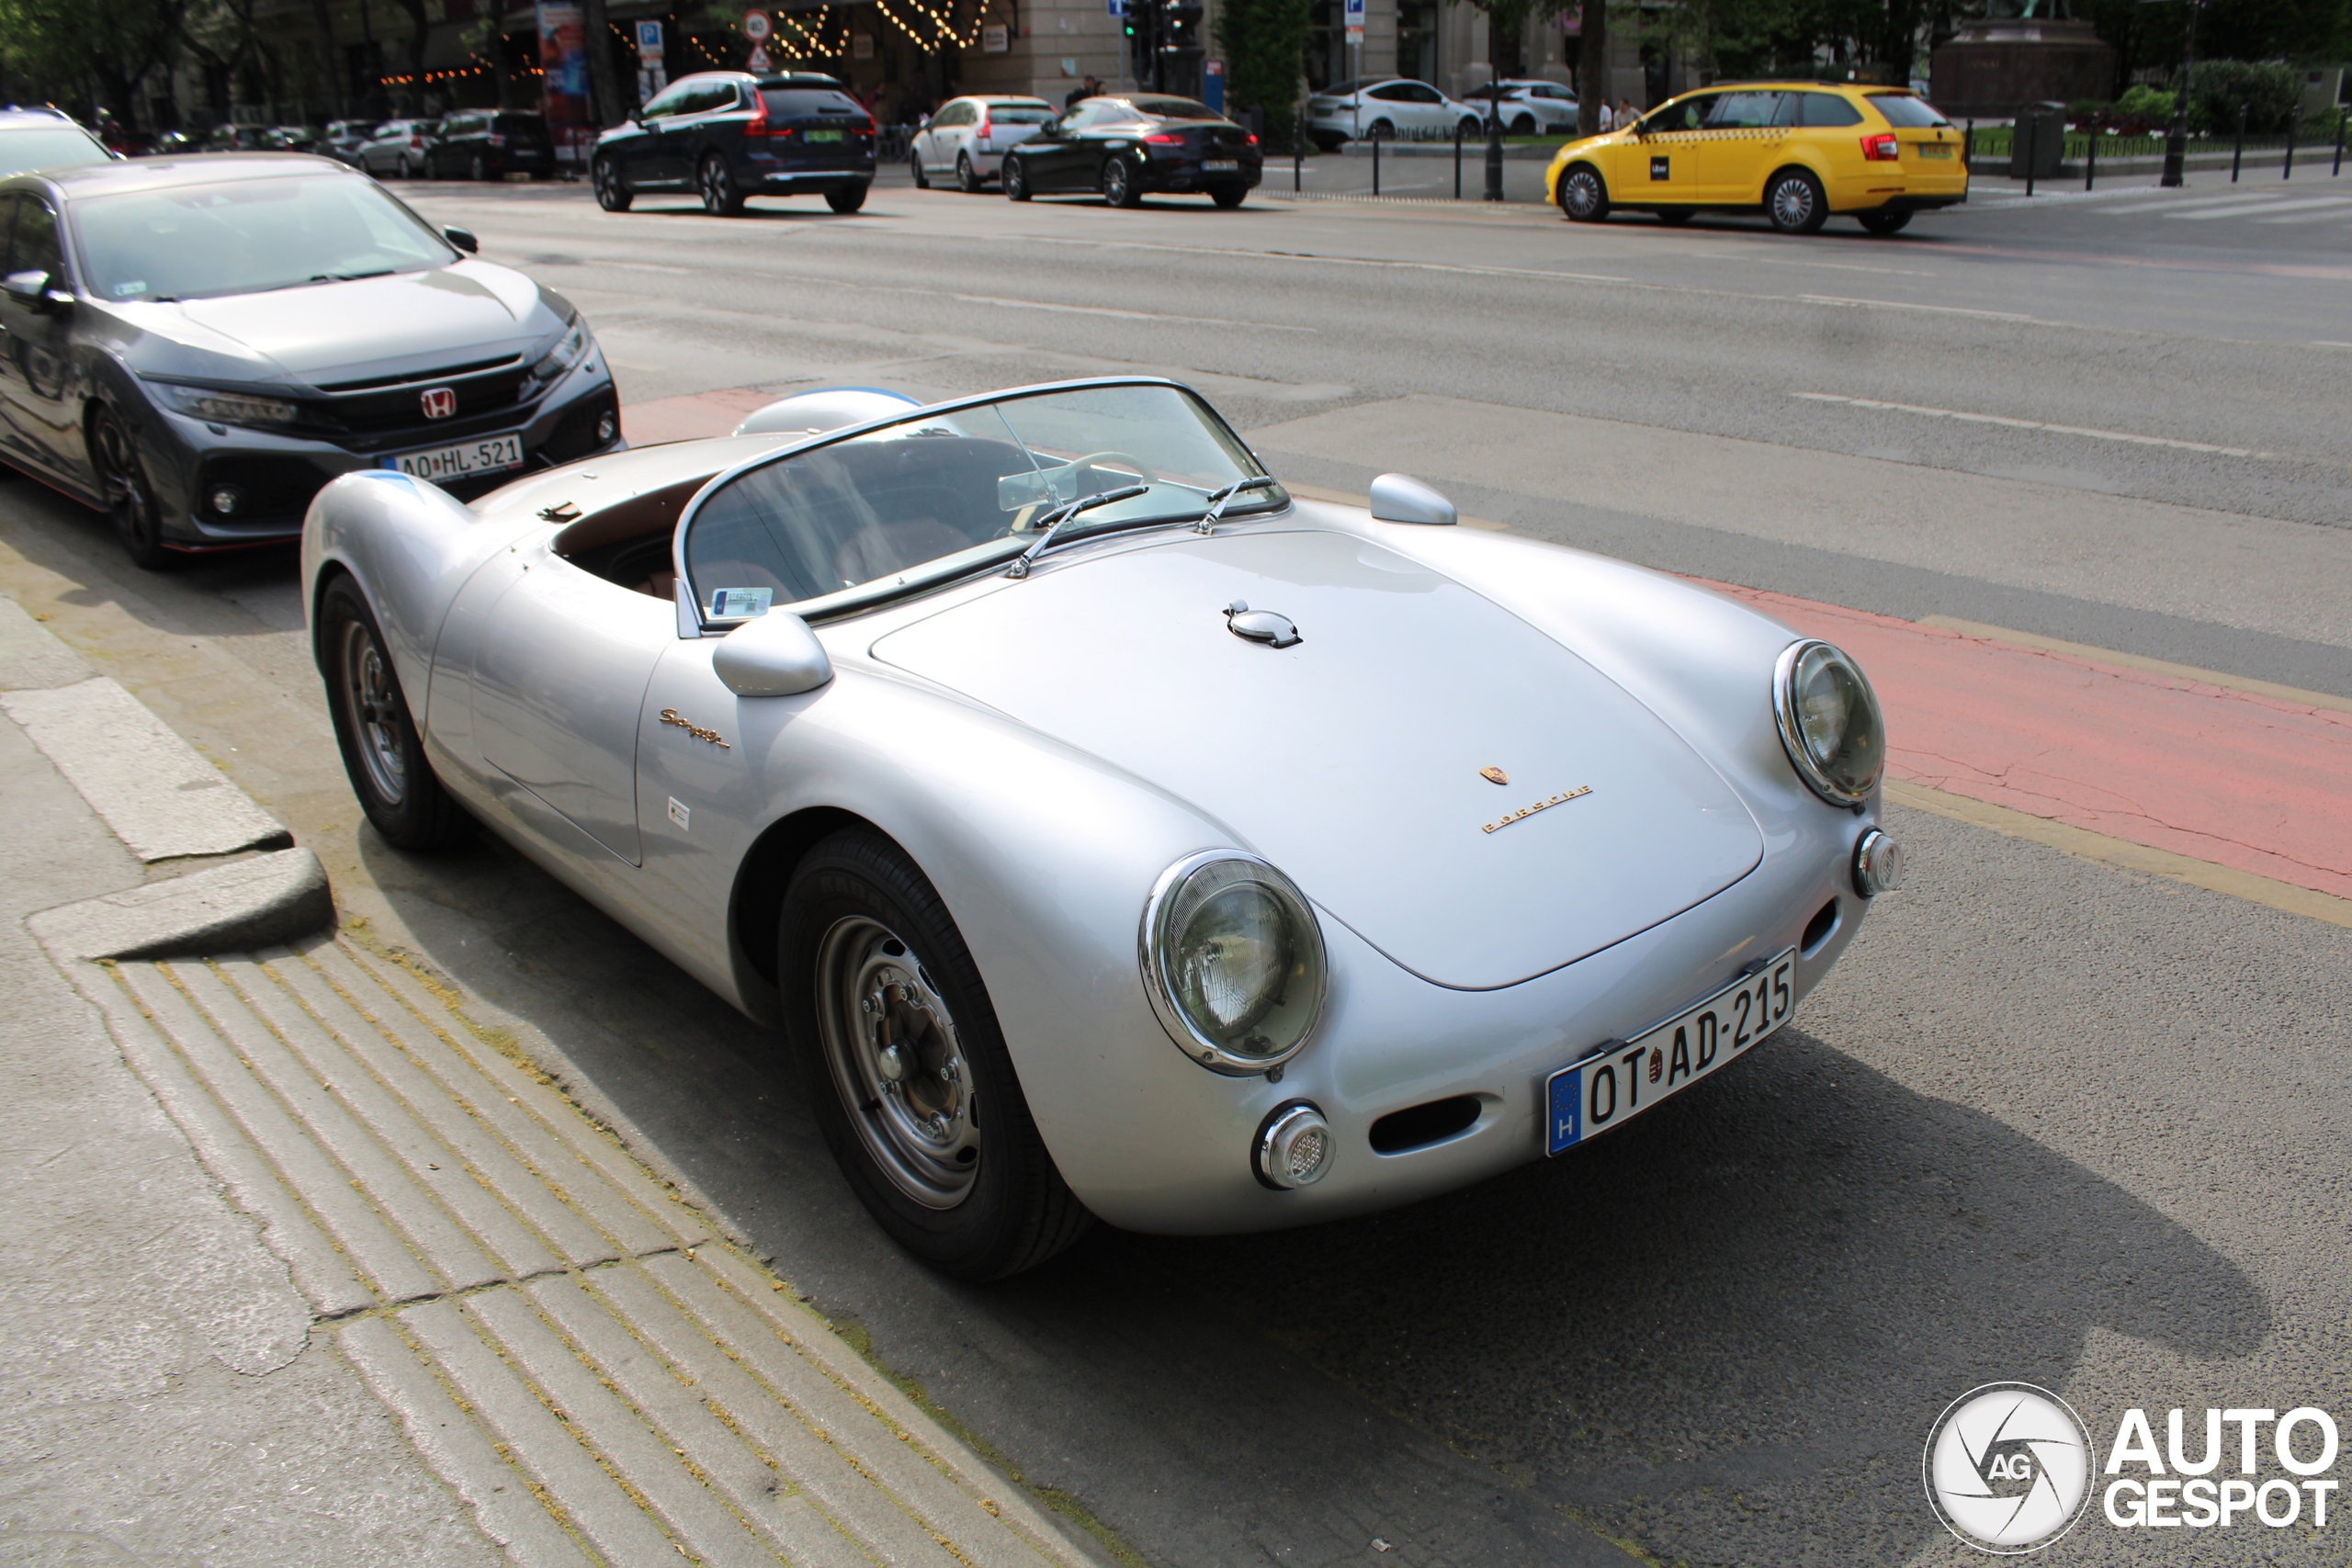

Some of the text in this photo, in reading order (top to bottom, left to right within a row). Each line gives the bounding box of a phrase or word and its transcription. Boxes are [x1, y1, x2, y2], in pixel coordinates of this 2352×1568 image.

[643, 26, 655, 41] P
[1481, 784, 1593, 834] PORSCHE
[1558, 1114, 1573, 1140] H
